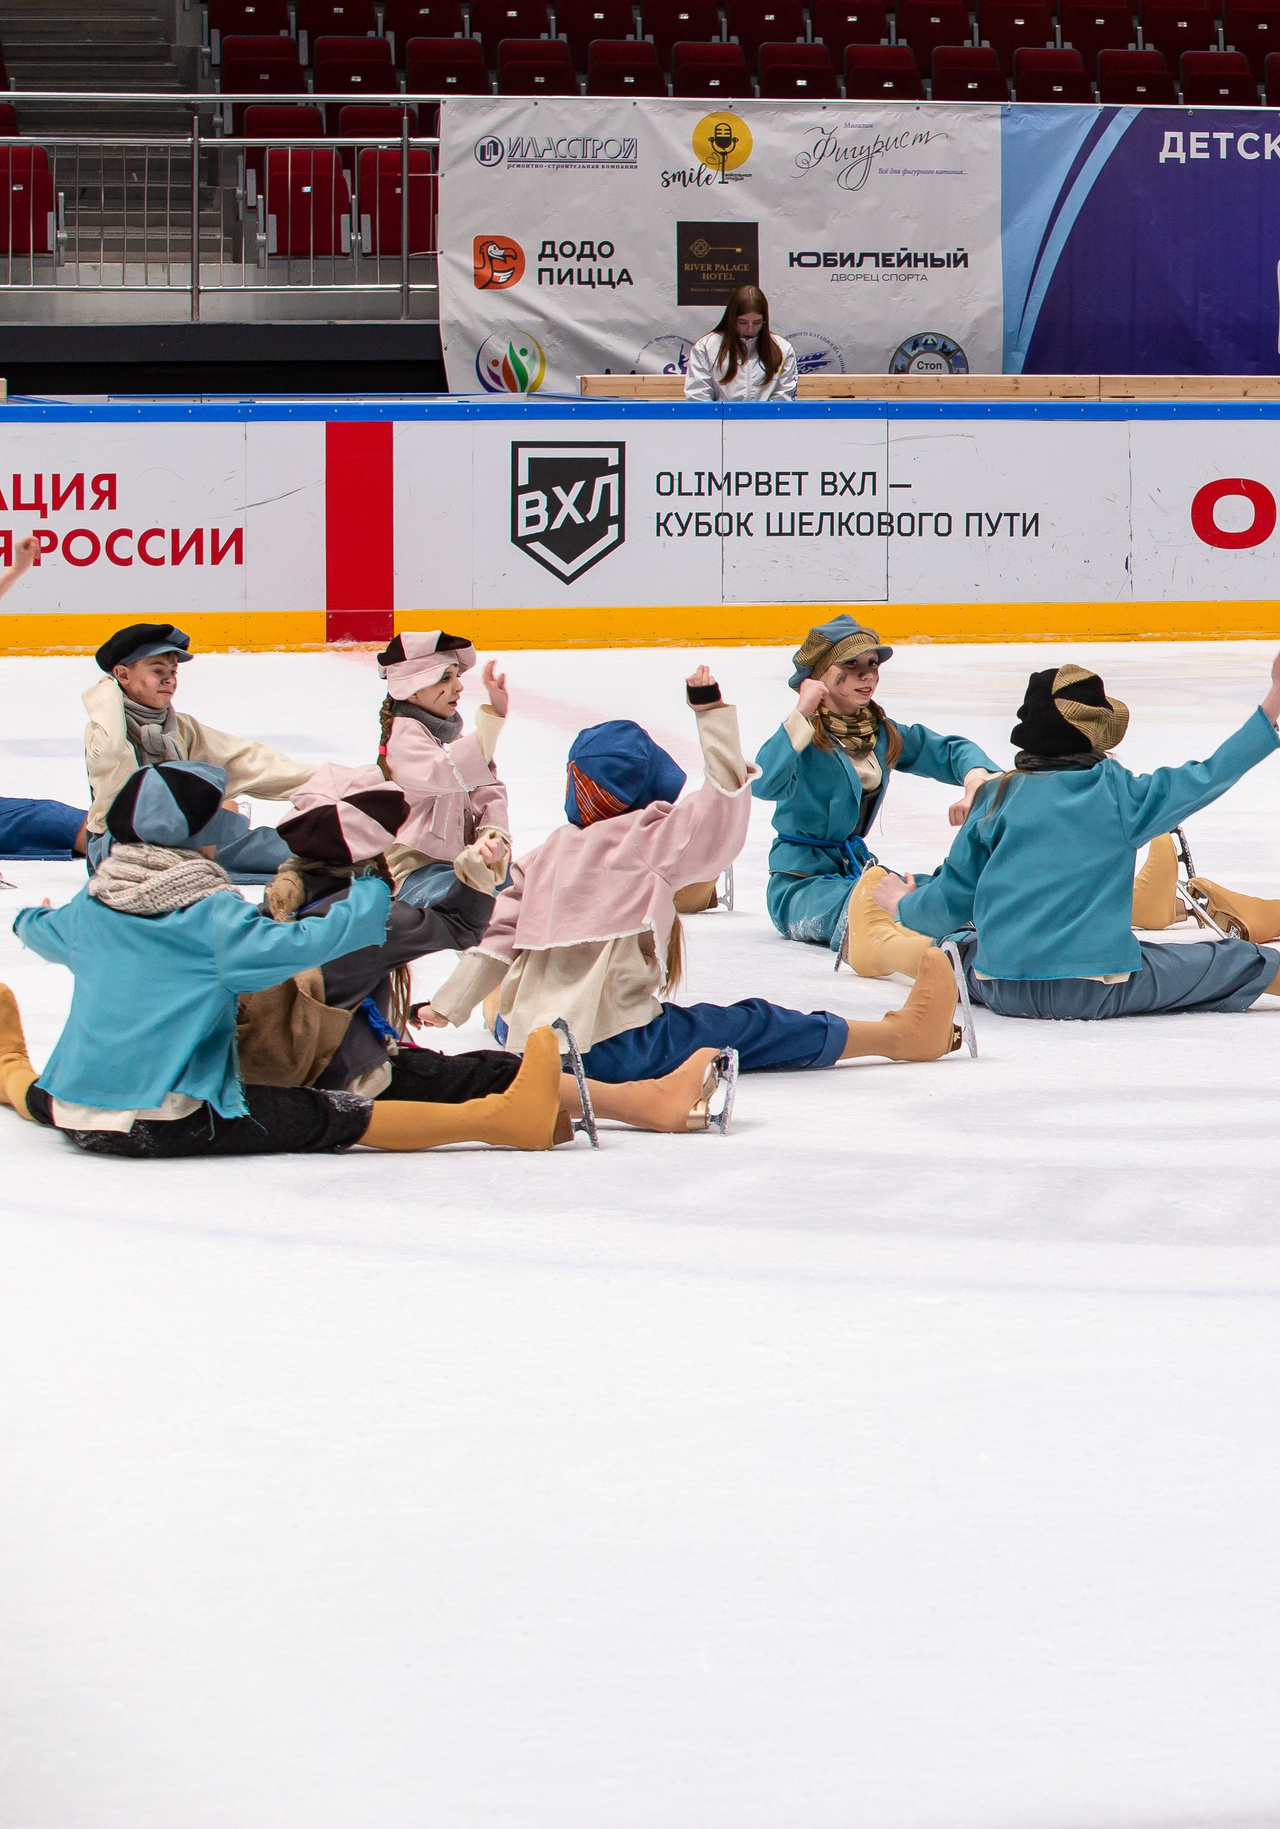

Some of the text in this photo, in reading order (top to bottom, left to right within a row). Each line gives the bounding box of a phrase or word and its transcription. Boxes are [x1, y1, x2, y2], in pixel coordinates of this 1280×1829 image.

[507, 136, 638, 159] ИЛАССТРОЙ
[790, 126, 949, 191] Фигурист
[507, 163, 600, 171] ремонтно-строительная
[661, 162, 717, 188] smile
[538, 240, 615, 262] ДОДО
[789, 247, 969, 268] ЮБИЛЕЙНЫЙ
[537, 268, 634, 289] ПИЦЦА
[684, 263, 750, 272] RIVER PALACE
[702, 272, 736, 280] HOTEL
[830, 273, 928, 283] ДВОРЕЦ СПОРТА
[916, 360, 943, 370] Стоп
[656, 471, 809, 496] OLIMPBET
[821, 471, 876, 496] ВХЛ
[0, 472, 117, 519] ЦИЯ
[518, 473, 619, 537] ВХЛ
[656, 512, 1040, 537] КУБОК ШЕЛКОВОГО ПУТИ
[33, 527, 243, 567] РОССИИ
